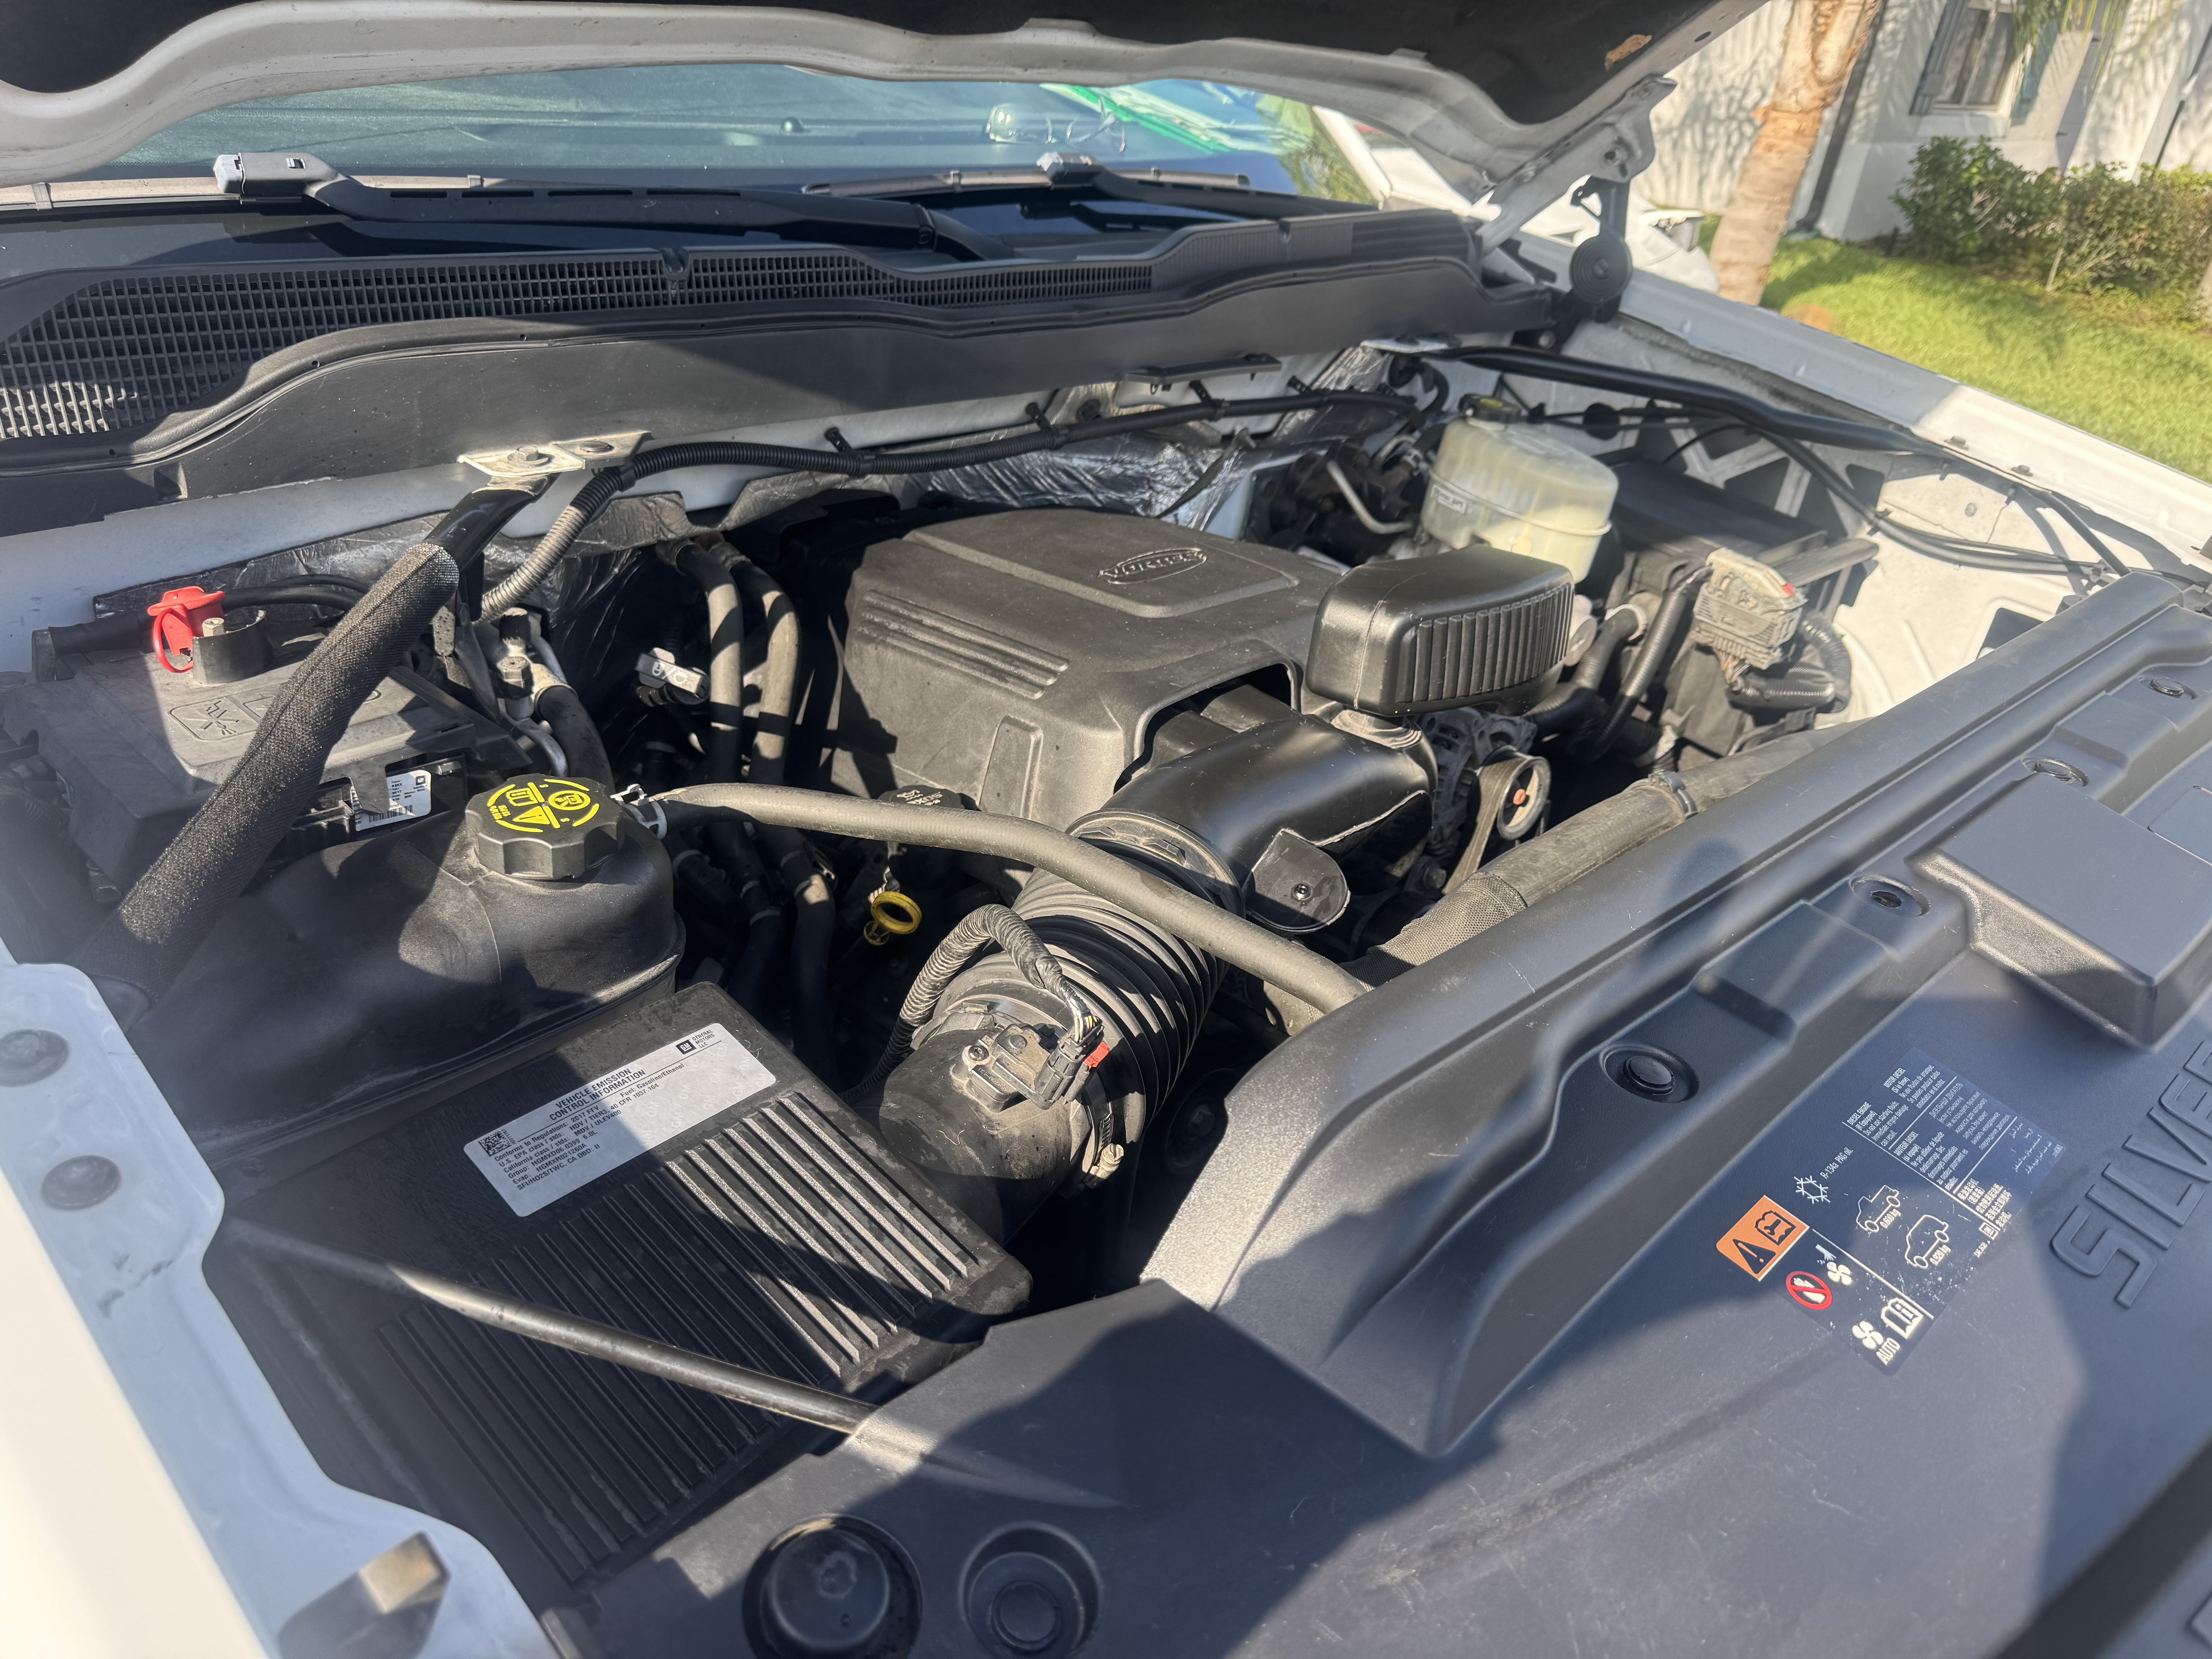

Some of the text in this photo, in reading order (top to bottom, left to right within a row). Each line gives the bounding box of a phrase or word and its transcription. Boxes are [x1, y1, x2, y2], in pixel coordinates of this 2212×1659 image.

[680, 1033, 714, 1051] GM MOTORS
[692, 1029, 713, 1040] GENERAL
[555, 1068, 631, 1108] VEHICLE EMISSION
[1883, 1067, 1905, 1088] MOTOR DIESEL
[549, 1070, 646, 1120] CONTROL INFORMATION
[494, 1145, 523, 1161] Conforms
[531, 1122, 568, 1142] Regulations:
[570, 1112, 585, 1122] 2017
[586, 1105, 598, 1114] FFV
[620, 1088, 636, 1097] Fuel:
[636, 1063, 684, 1089] Gasoline/Ethanol
[1847, 1101, 1871, 1125] DIESEL ENGINE
[1858, 1110, 1877, 1126] Equipped)
[1871, 1104, 1908, 1141] Immediate engine damage
[1878, 1108, 1893, 1121] starting
[1887, 1101, 1899, 1110] fluids.
[499, 1158, 513, 1167] U.S.
[514, 1150, 527, 1159] EPA
[529, 1142, 544, 1152] class
[549, 1132, 564, 1141] stds:
[569, 1121, 583, 1130] HDV
[588, 1109, 610, 1120] TIER3,
[618, 1097, 632, 1105] CFR
[633, 1083, 659, 1098] 1037.104
[503, 1156, 533, 1173] California
[534, 1147, 550, 1157] class
[555, 1137, 570, 1146] stds:
[574, 1126, 589, 1136] MDV
[594, 1109, 621, 1125] ULEV400
[577, 1148, 594, 1158] OBD:
[1893, 1131, 1918, 1156] MOTEUR DIESEL
[1915, 1155, 1923, 1163] pas
[1932, 1132, 1944, 1143] liquide
[508, 1130, 598, 1178] Group: HGMXD06.0399 6.0L
[1820, 1147, 1853, 1179] R-134a PAG oil.
[1940, 1167, 1952, 1180] moteur
[1949, 1152, 1965, 1170] pourraient
[512, 1173, 531, 1184] Evap:
[1927, 1161, 1945, 1178] dommages
[1891, 1209, 1901, 1218] kg
[1939, 1245, 1951, 1254] kg
[1876, 1338, 1900, 1365] AUTO
